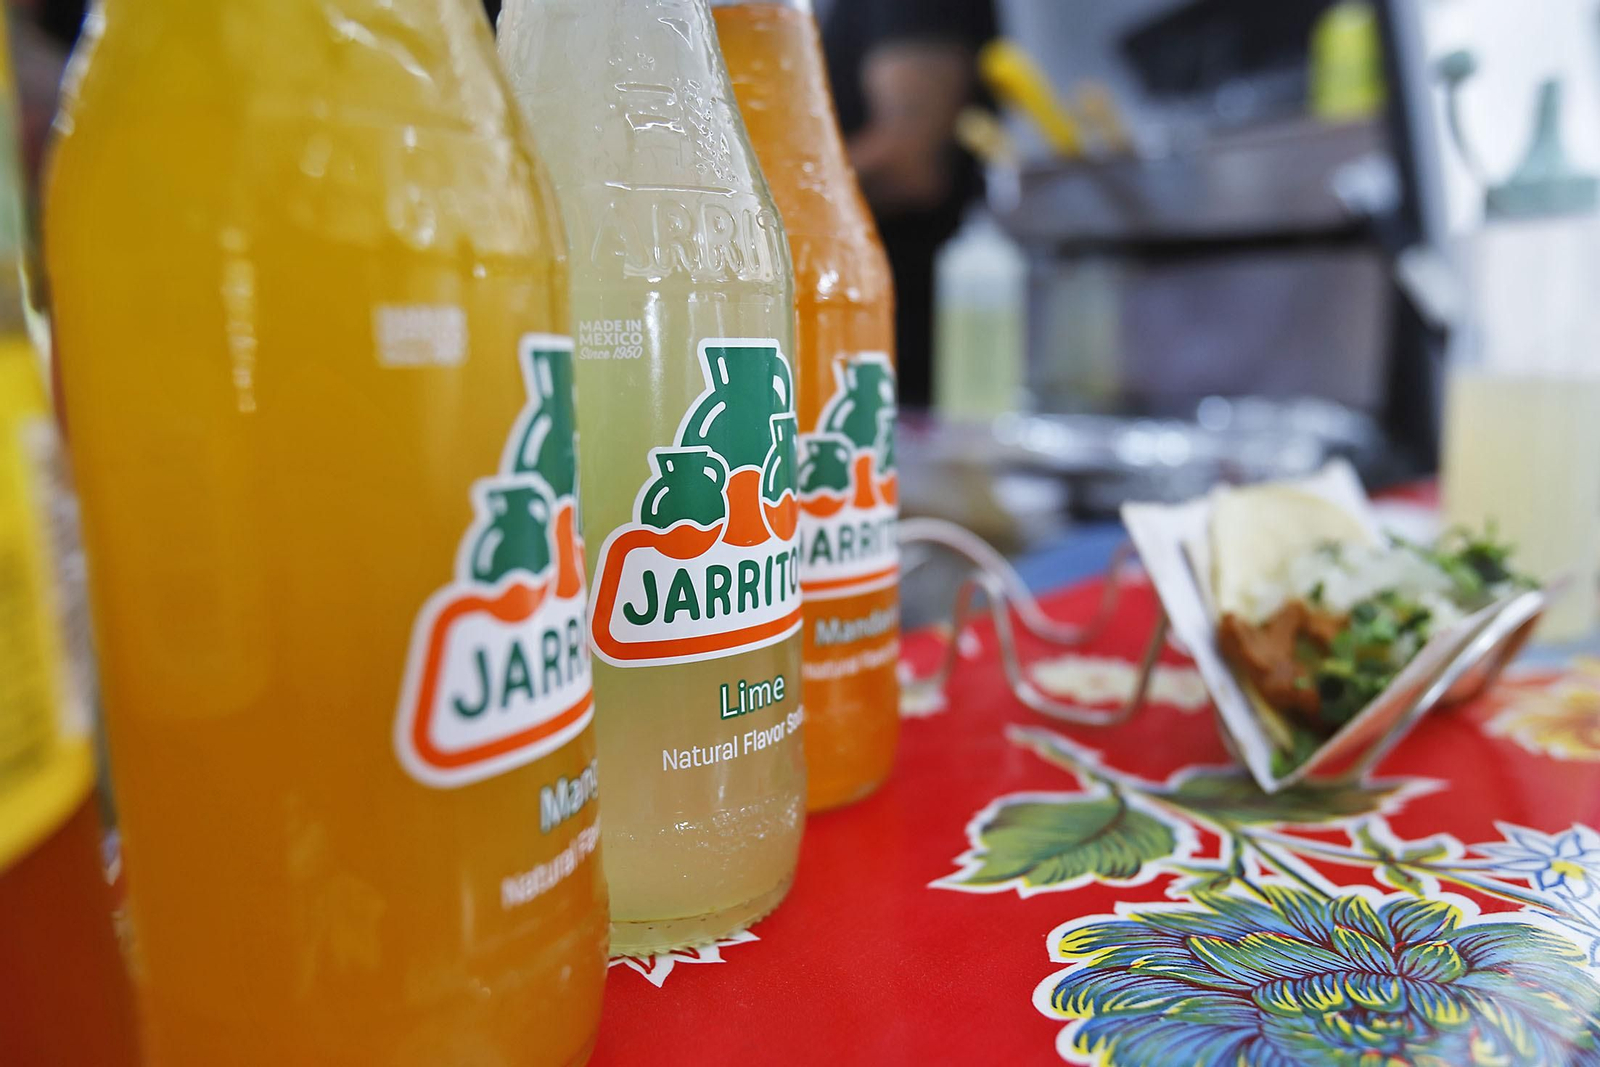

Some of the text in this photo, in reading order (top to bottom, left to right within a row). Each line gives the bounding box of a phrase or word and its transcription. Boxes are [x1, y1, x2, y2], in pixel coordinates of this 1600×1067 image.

[590, 202, 785, 276] ARRIT
[579, 319, 642, 333] MADE IN
[579, 331, 644, 346] MEXICO
[579, 345, 643, 360] Since 1950
[622, 546, 798, 626] JARRITO
[452, 614, 587, 720] JARR
[720, 674, 785, 721] Lime
[662, 735, 738, 771] Natural
[743, 721, 786, 755] Flavor
[540, 757, 599, 834] Mang
